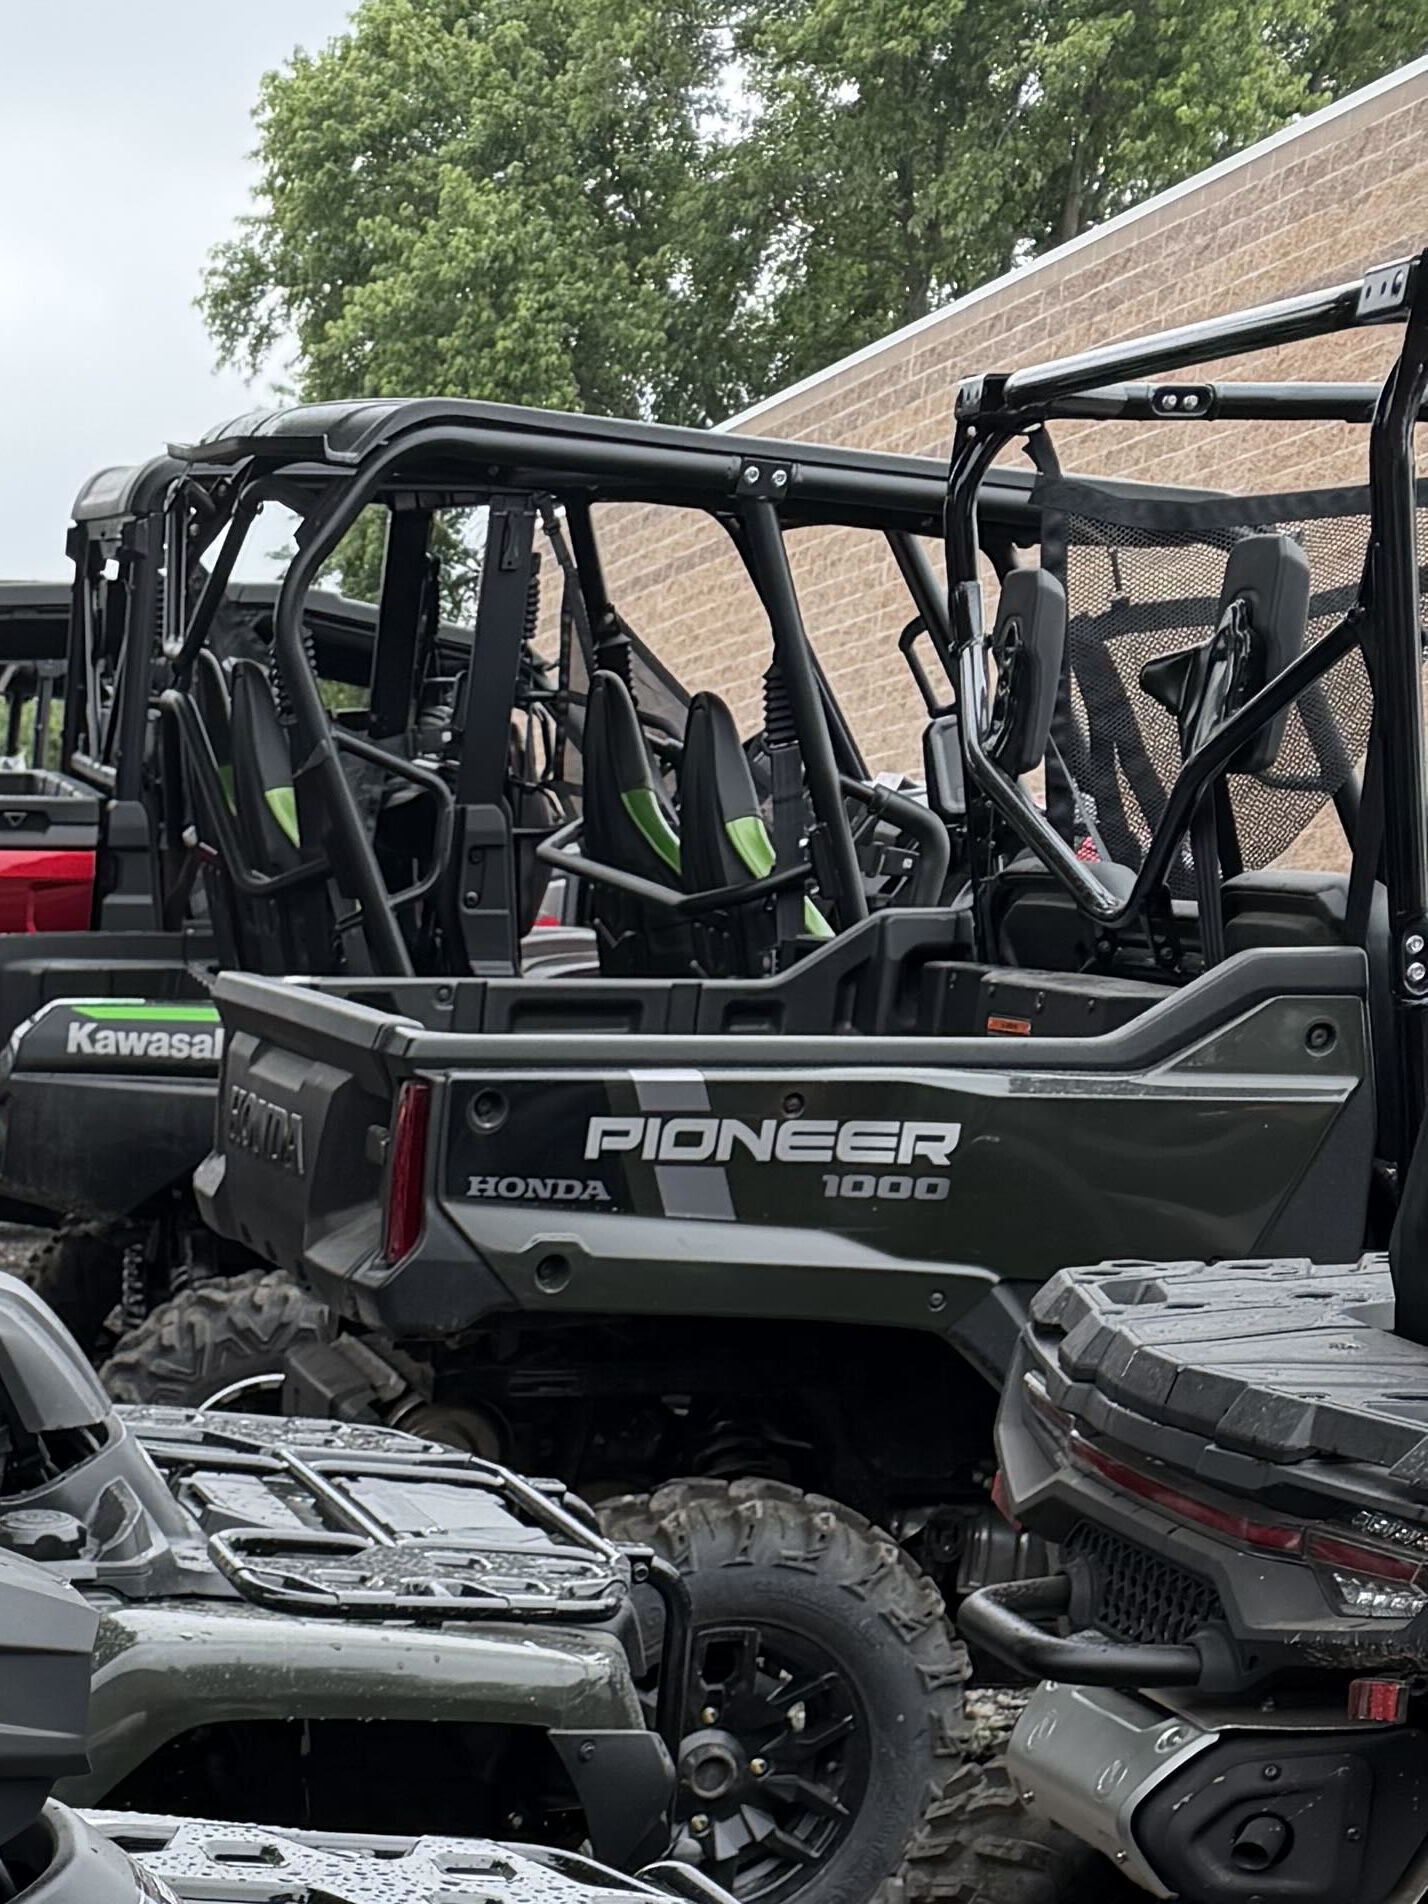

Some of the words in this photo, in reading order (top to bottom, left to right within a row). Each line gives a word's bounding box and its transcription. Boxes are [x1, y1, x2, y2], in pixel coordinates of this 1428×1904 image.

[67, 1022, 226, 1060] Kawasa
[583, 1116, 962, 1166] PIONEER
[466, 1175, 612, 1201] HONDA
[821, 1173, 952, 1201] 1000
